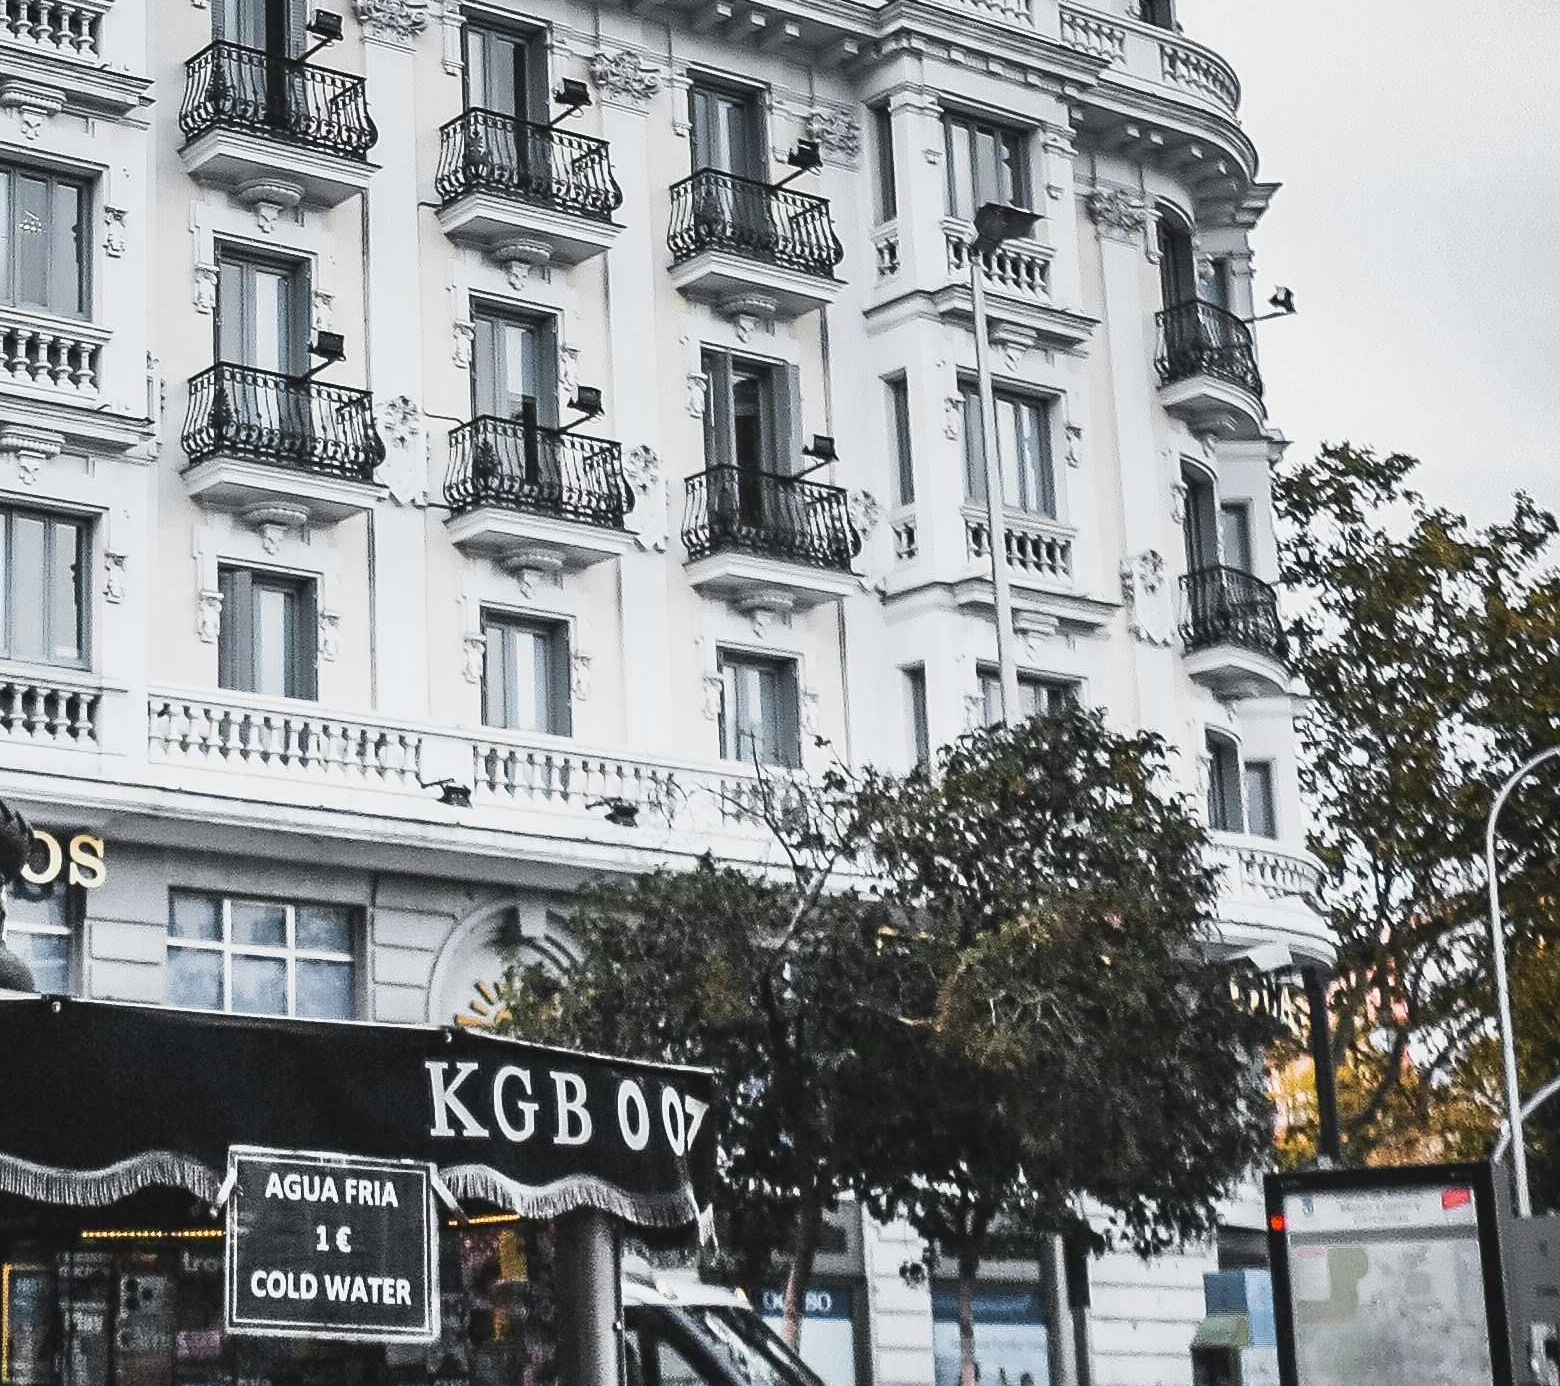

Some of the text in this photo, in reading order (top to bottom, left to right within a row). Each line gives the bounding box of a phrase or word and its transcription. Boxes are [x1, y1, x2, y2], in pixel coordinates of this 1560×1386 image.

[424, 1060, 593, 1145] KGB
[265, 1172, 399, 1208] AGUA FRIA
[250, 1270, 412, 1306] COLD WATER
